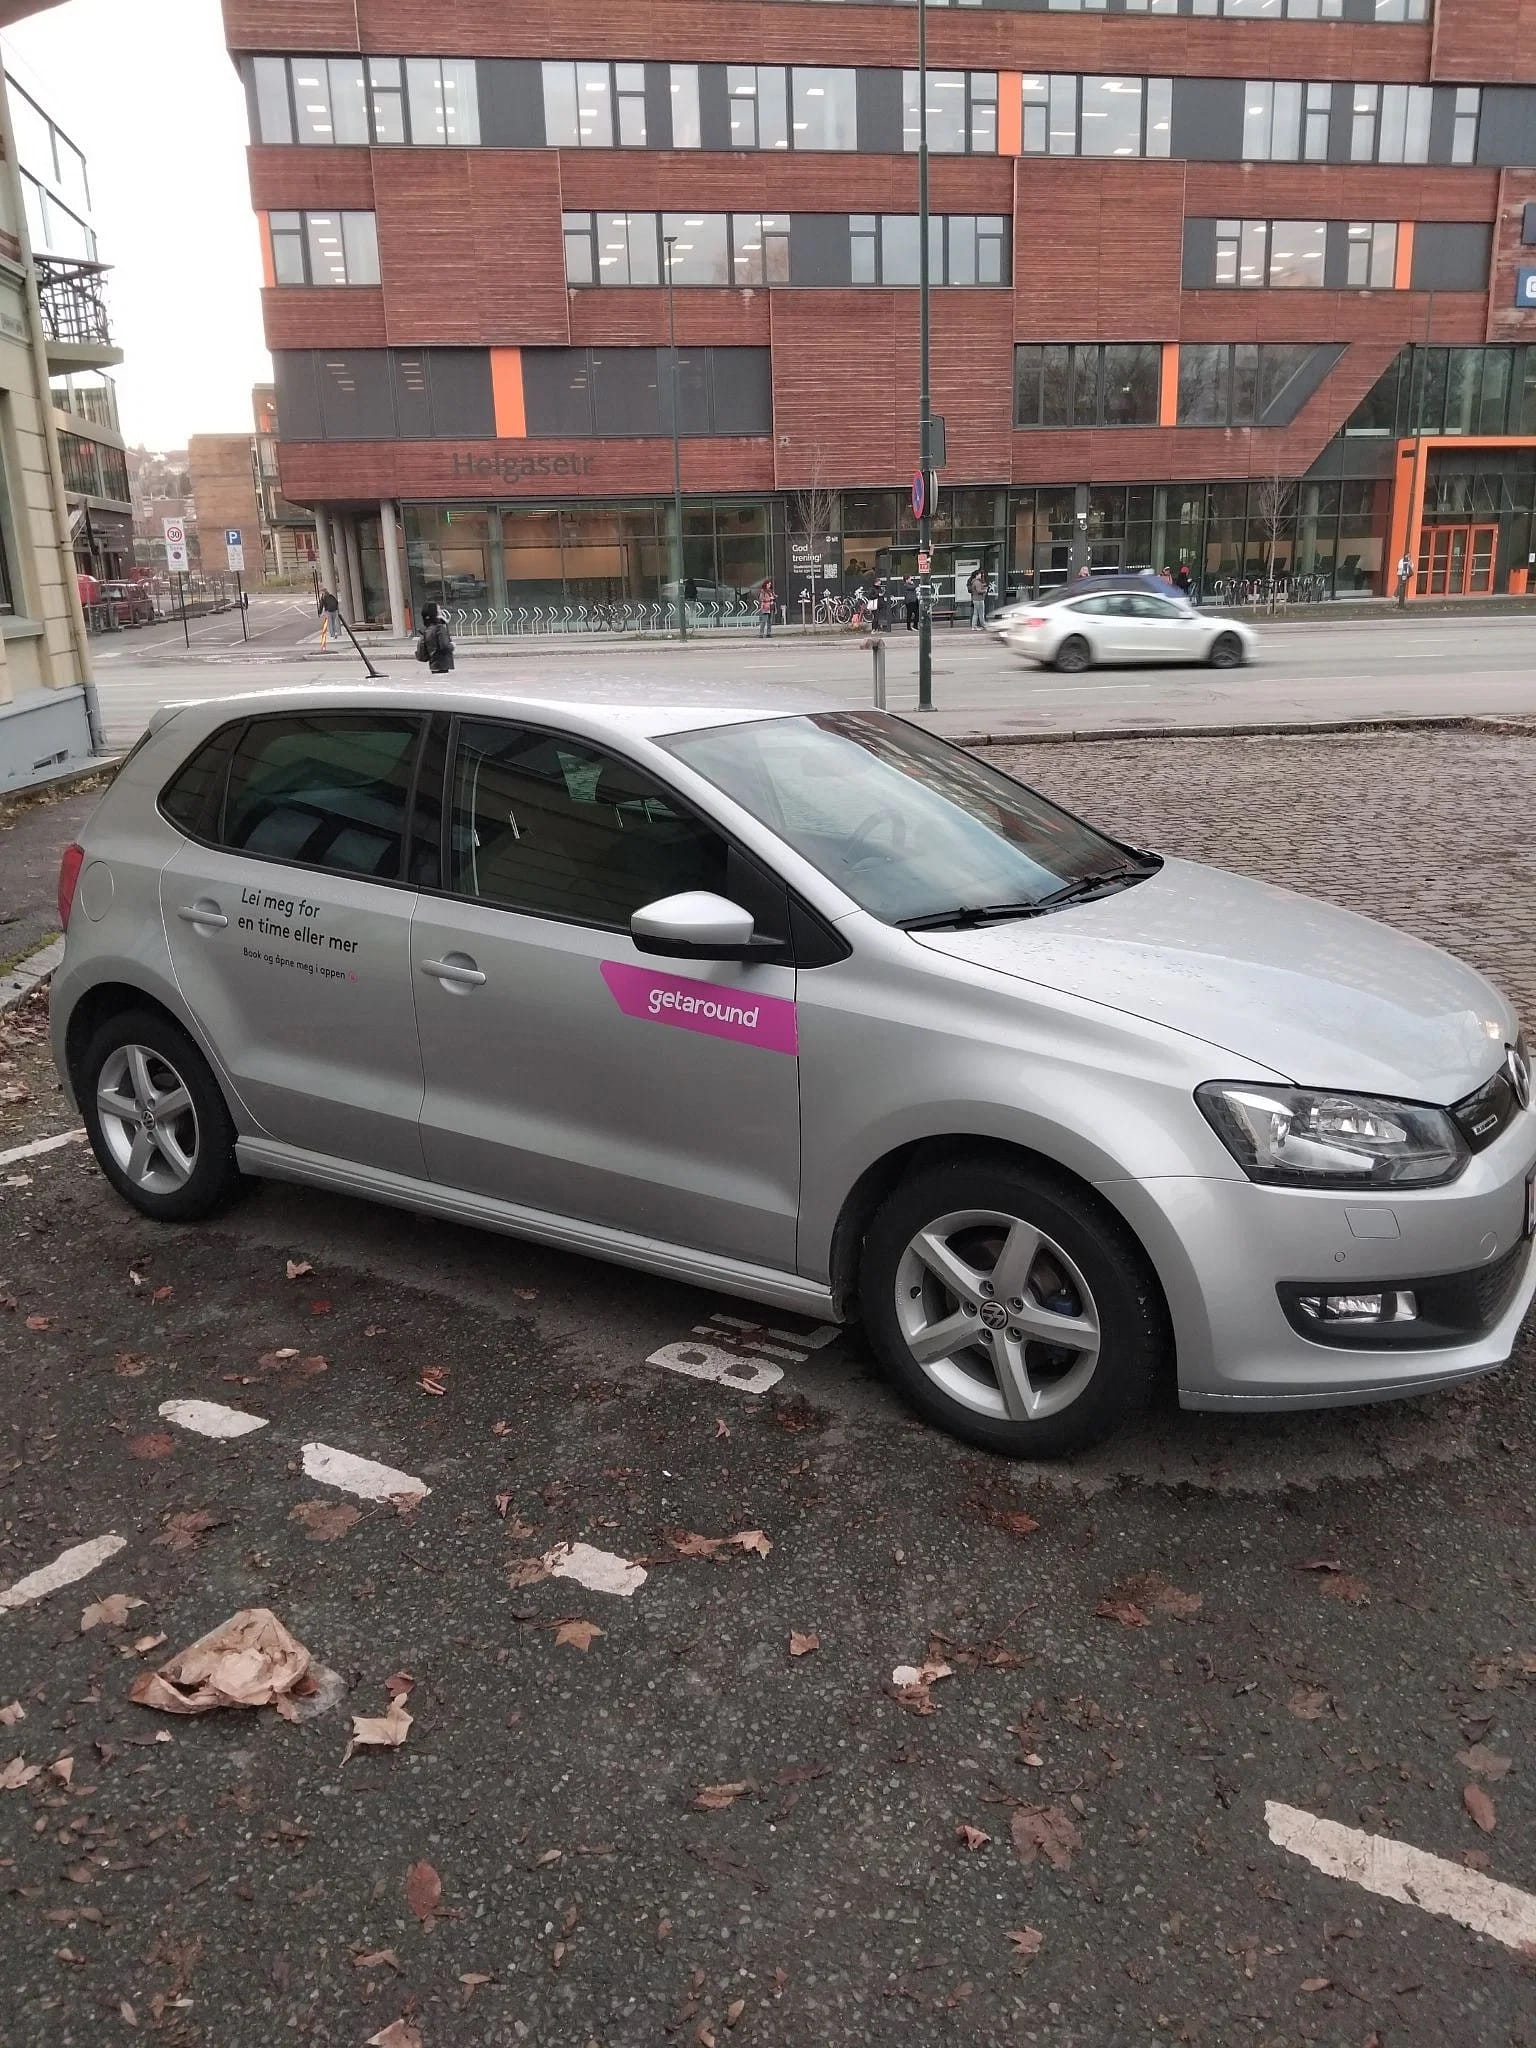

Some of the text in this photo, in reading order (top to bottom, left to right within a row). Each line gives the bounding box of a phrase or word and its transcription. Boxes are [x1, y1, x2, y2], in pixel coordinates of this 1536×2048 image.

[452, 451, 594, 484] Helgasetr
[229, 531, 238, 544] P
[792, 554, 822, 562] trening!
[241, 888, 320, 918] Lei meg for
[238, 917, 358, 953] en time eller mer
[243, 947, 262, 960] Book
[263, 954, 274, 965] og
[275, 954, 295, 967] åpne
[296, 961, 314, 975] meg
[320, 967, 346, 980] appen
[648, 989, 760, 1028] getaround
[645, 1313, 843, 1394] BIL
